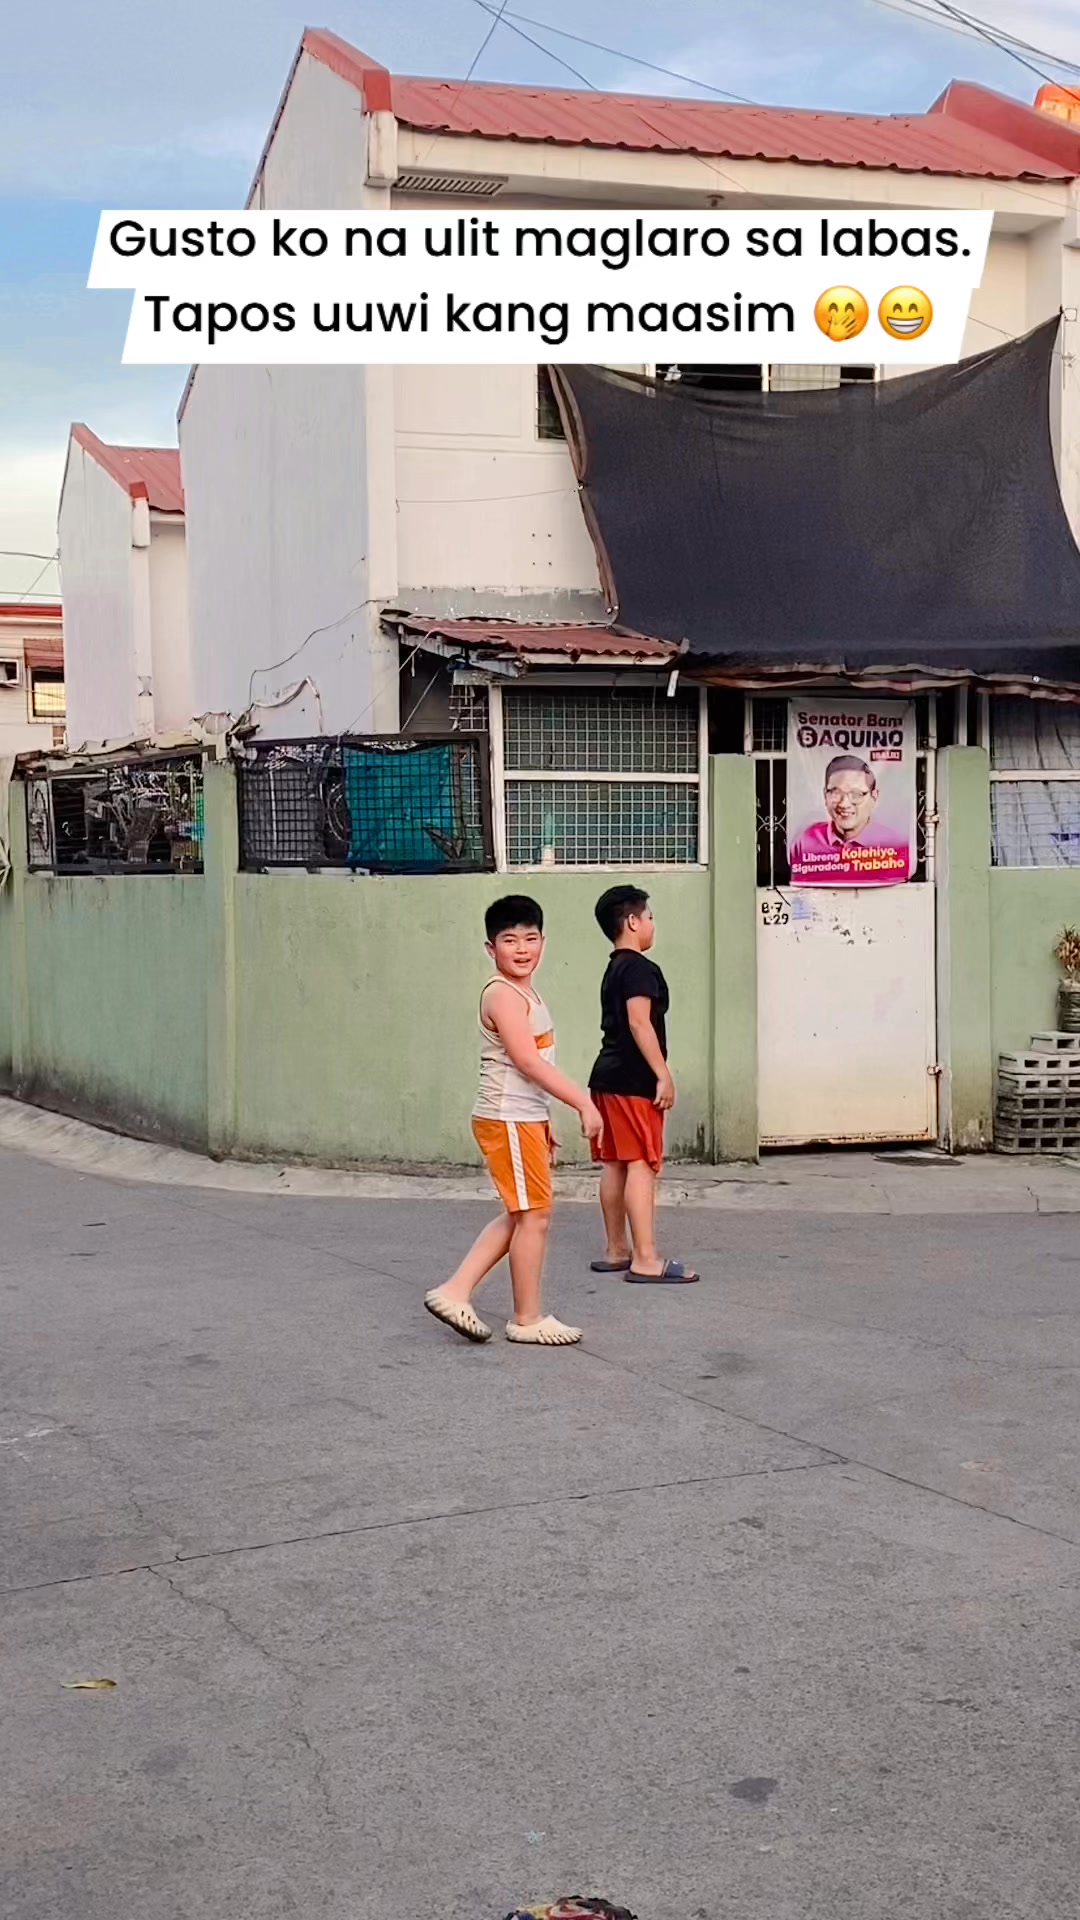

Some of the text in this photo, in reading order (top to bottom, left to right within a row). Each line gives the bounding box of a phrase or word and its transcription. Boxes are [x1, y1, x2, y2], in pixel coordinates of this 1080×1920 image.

[798, 712, 863, 726] Senator
[797, 726, 903, 750] 5 AQUINO
[802, 846, 898, 862] Libreng Kolehiyo.
[792, 858, 905, 874] Siguradong Trabaho
